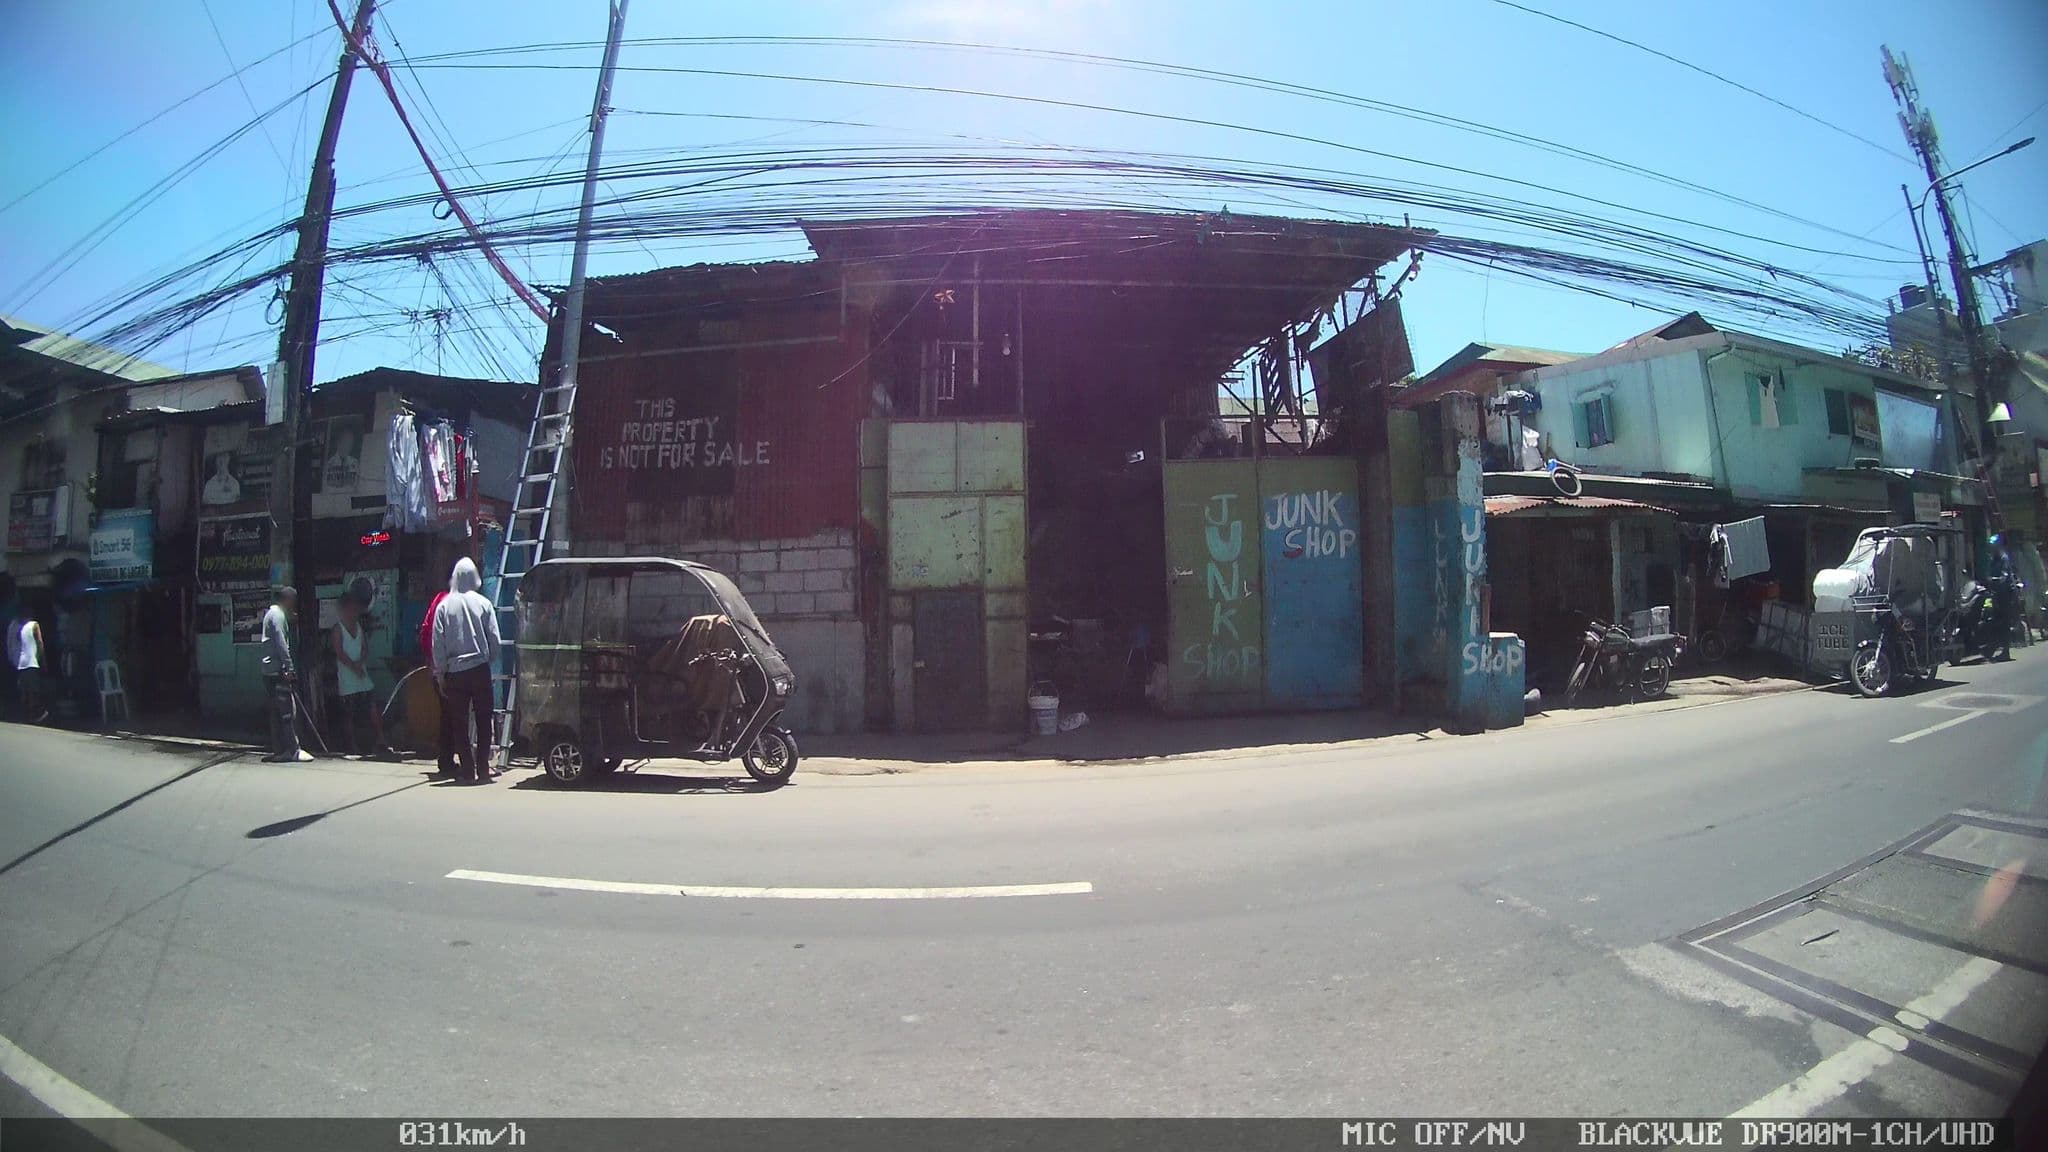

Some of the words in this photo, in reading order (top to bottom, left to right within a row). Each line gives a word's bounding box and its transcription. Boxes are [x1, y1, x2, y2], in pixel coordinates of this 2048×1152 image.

[635, 397, 676, 418] THIS
[621, 416, 719, 443] PROPERTY
[600, 447, 613, 469] IS
[618, 444, 655, 470] NOT
[657, 441, 697, 469] FOR
[703, 440, 770, 468] SALE
[1264, 489, 1345, 530] JUNK
[1284, 528, 1356, 558] SHOP
[1204, 494, 1242, 641] JUNK
[1817, 637, 1850, 649] TUBE
[1819, 624, 1849, 636] ICE
[1183, 643, 1259, 680] SHOP
[1462, 641, 1522, 676] SHOP
